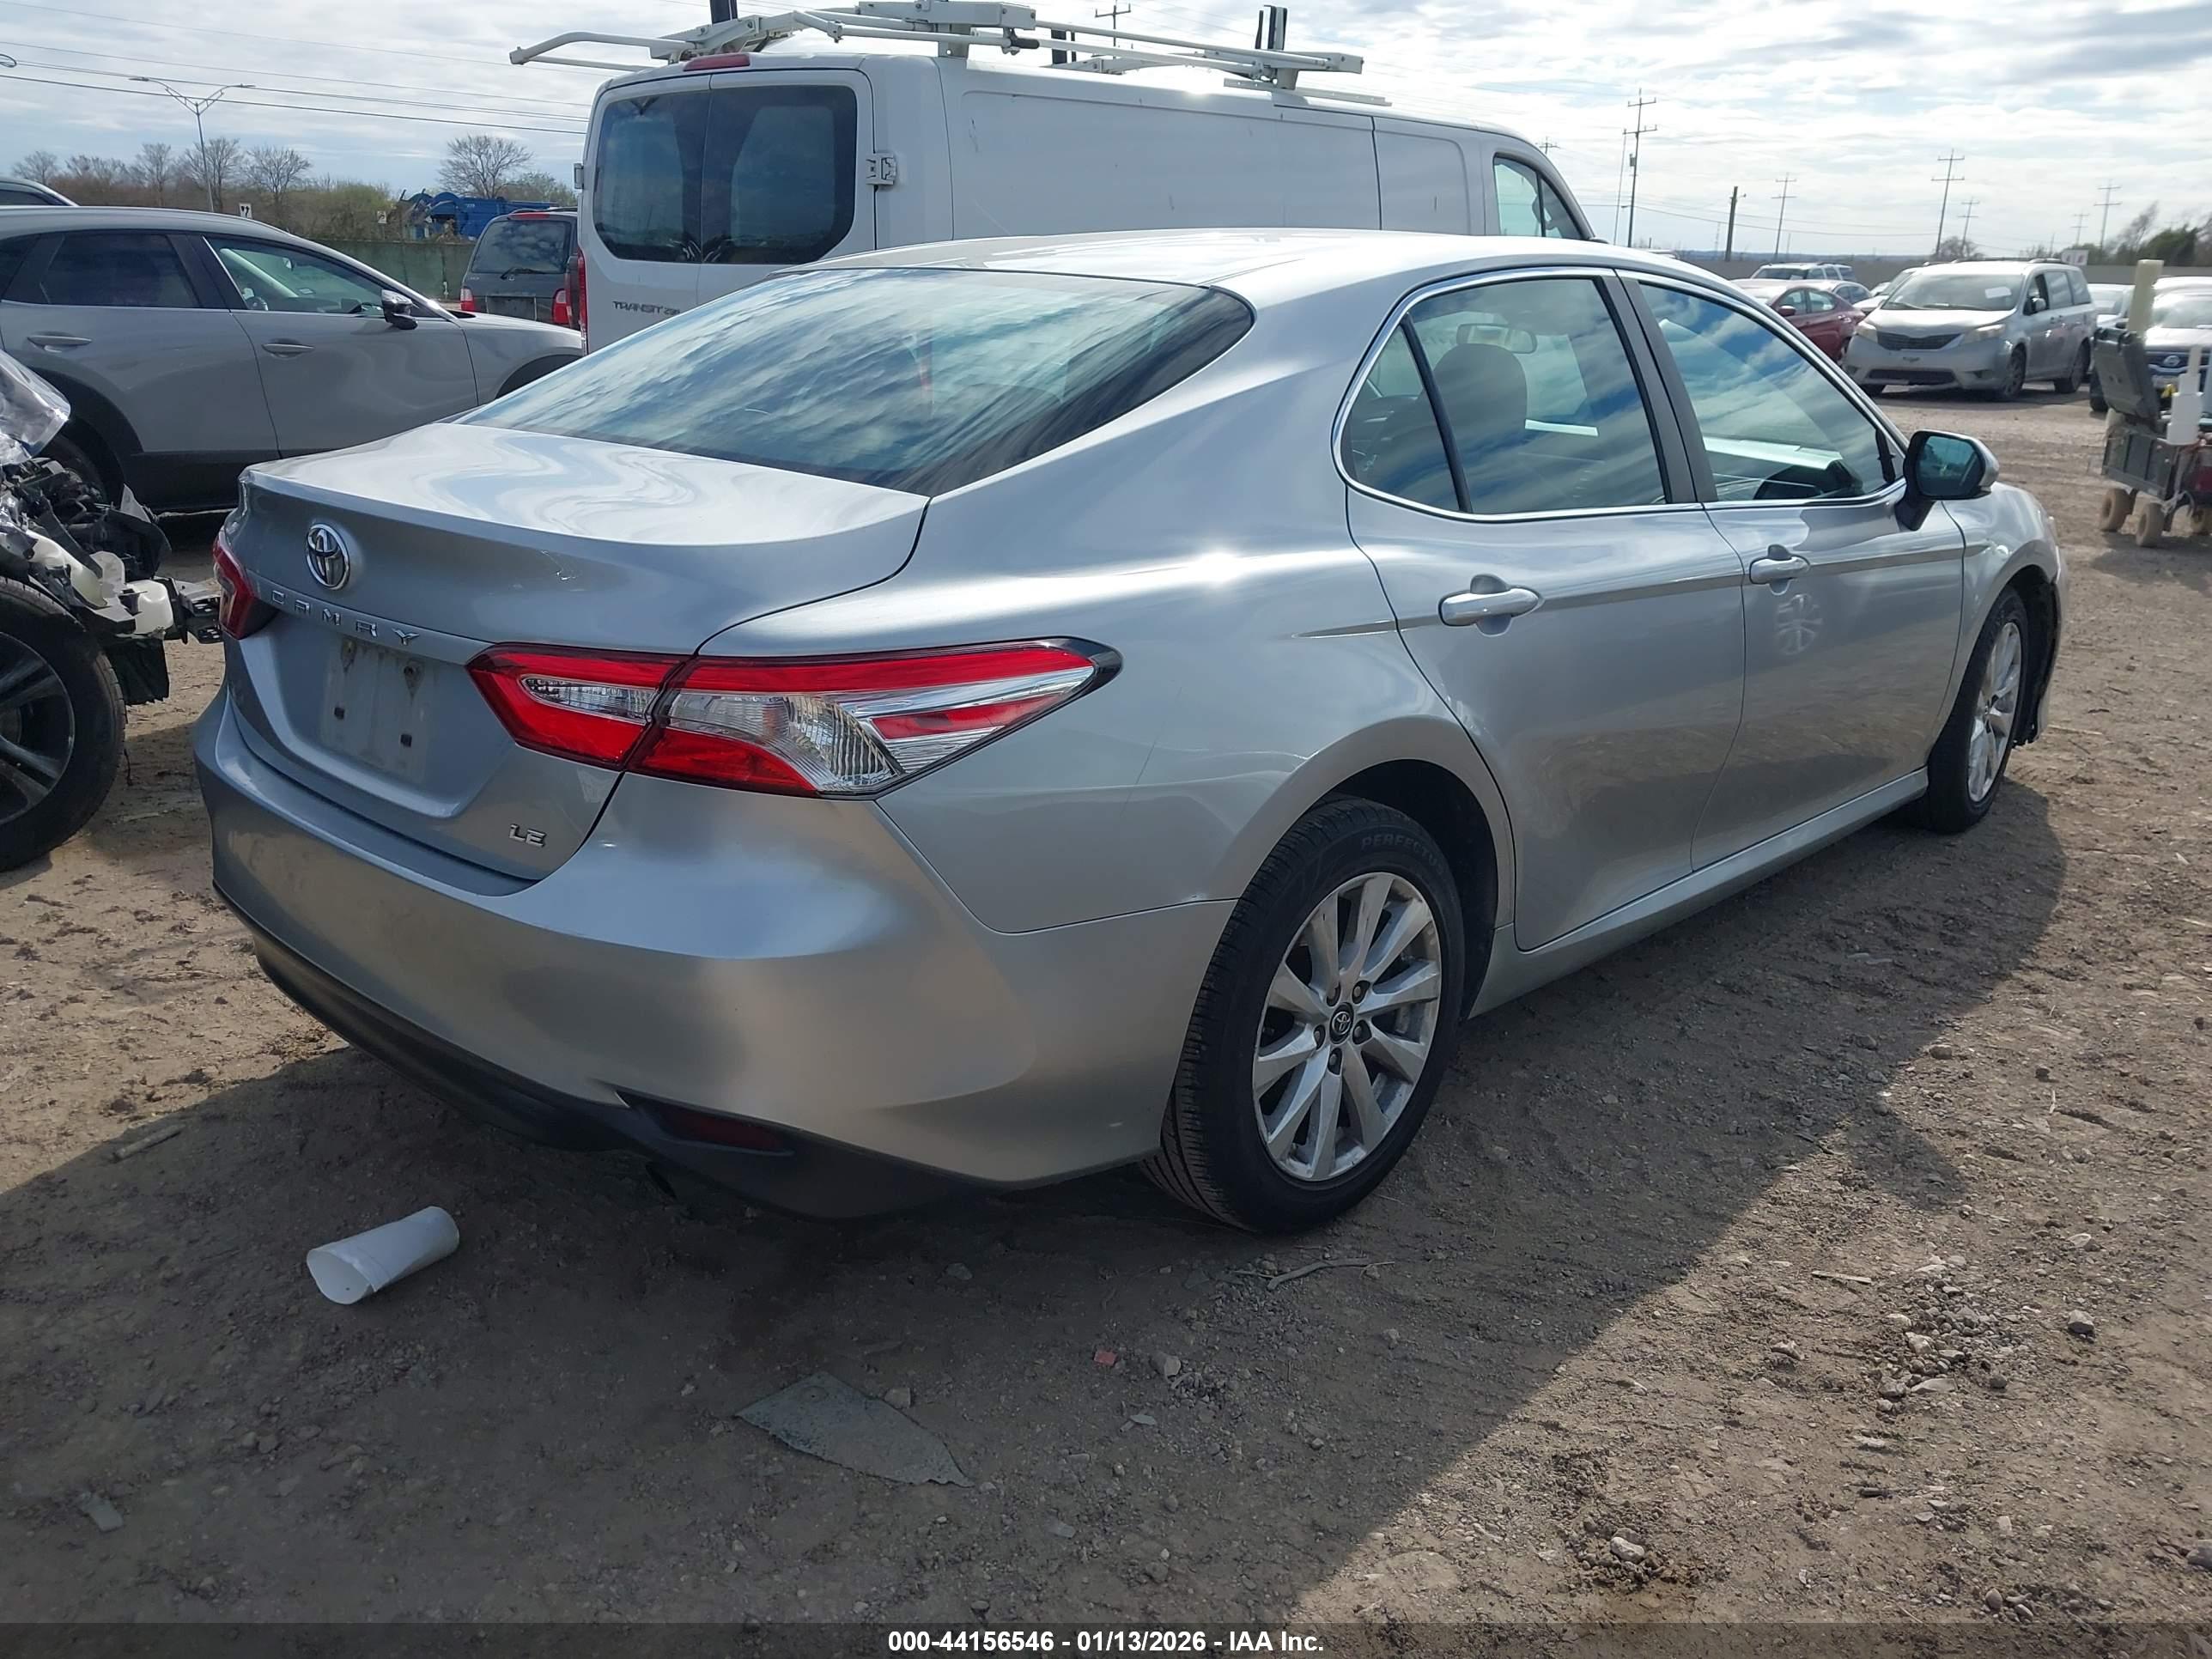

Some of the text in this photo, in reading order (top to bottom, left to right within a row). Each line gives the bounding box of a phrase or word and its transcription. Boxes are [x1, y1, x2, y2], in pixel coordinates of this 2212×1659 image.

[612, 301, 663, 314] TRANSIT
[271, 589, 420, 646] CAMRY
[509, 823, 547, 848] LE
